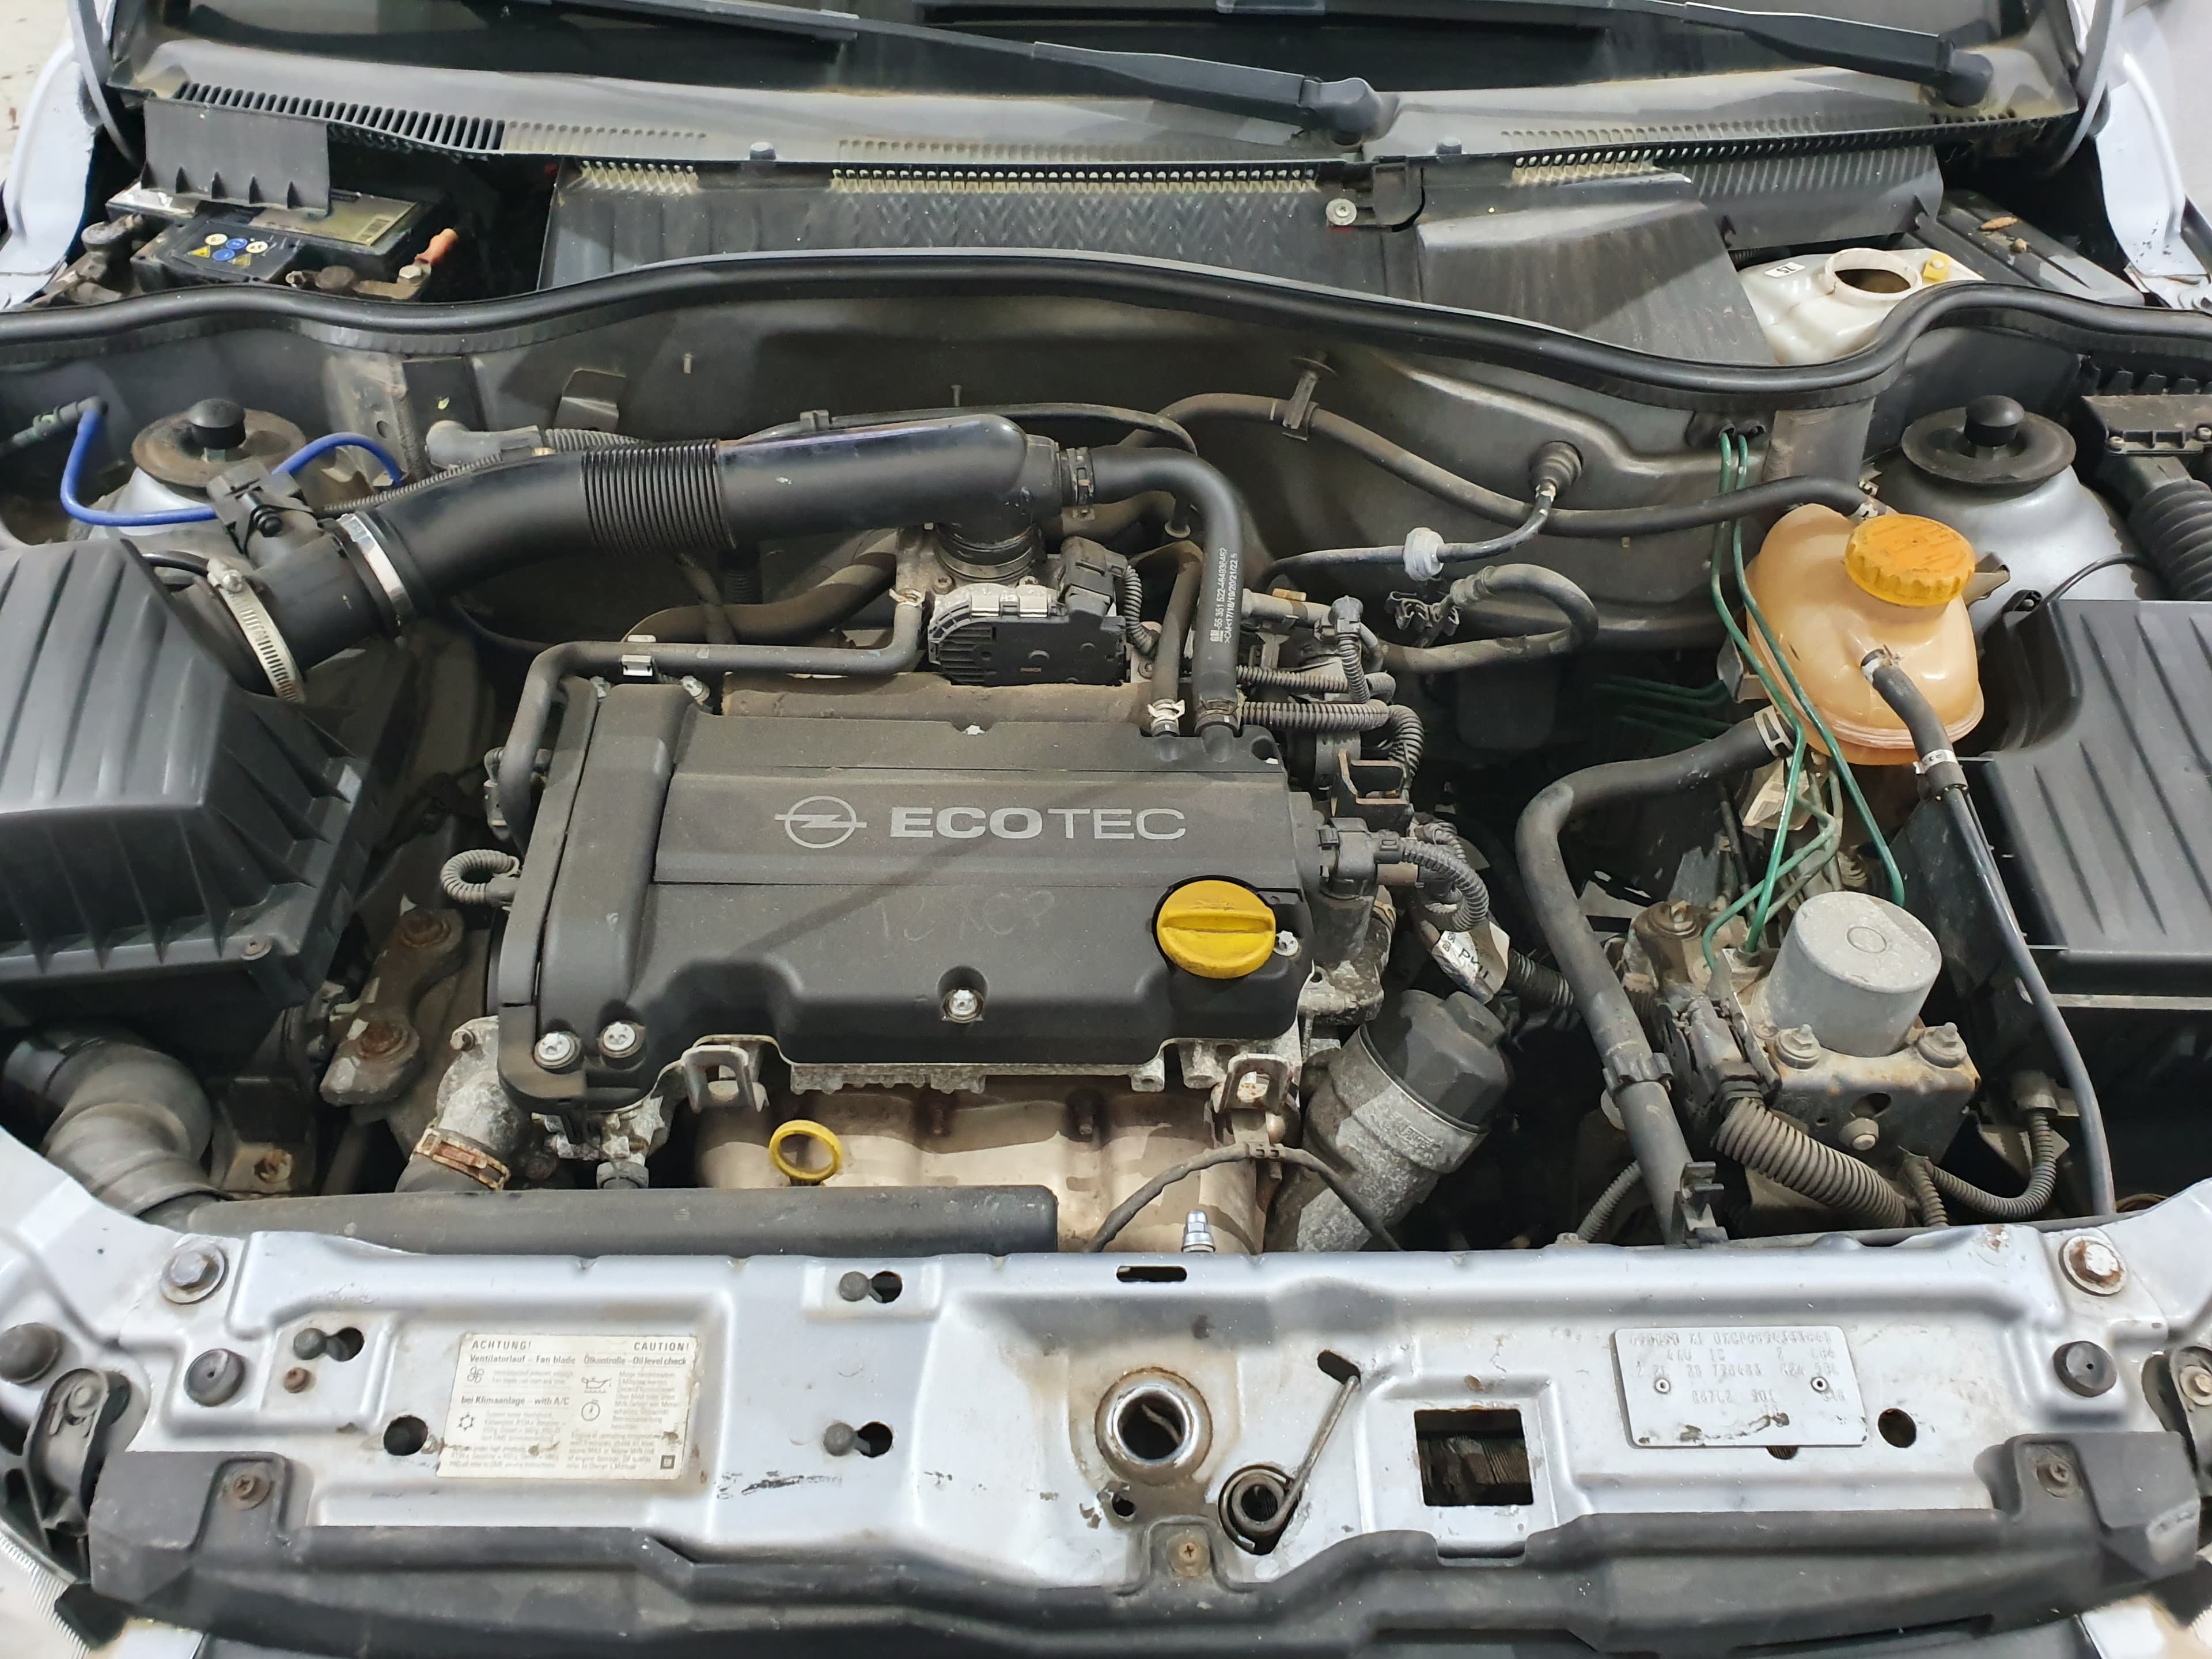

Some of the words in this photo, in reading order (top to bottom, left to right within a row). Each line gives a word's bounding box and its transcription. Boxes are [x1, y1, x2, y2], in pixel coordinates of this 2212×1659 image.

[889, 806, 1187, 840] ECOTEC
[471, 1340, 531, 1350] ACHTUNG!
[634, 1342, 689, 1351] CAUTION!
[470, 1354, 525, 1363] Ventilatorlauf
[536, 1355, 550, 1363] Fan
[553, 1355, 576, 1365] blade
[664, 1357, 687, 1365] check
[461, 1396, 474, 1404] bei
[475, 1396, 525, 1406] Klimaanlage
[535, 1397, 552, 1405] with
[553, 1397, 570, 1406] A/C
